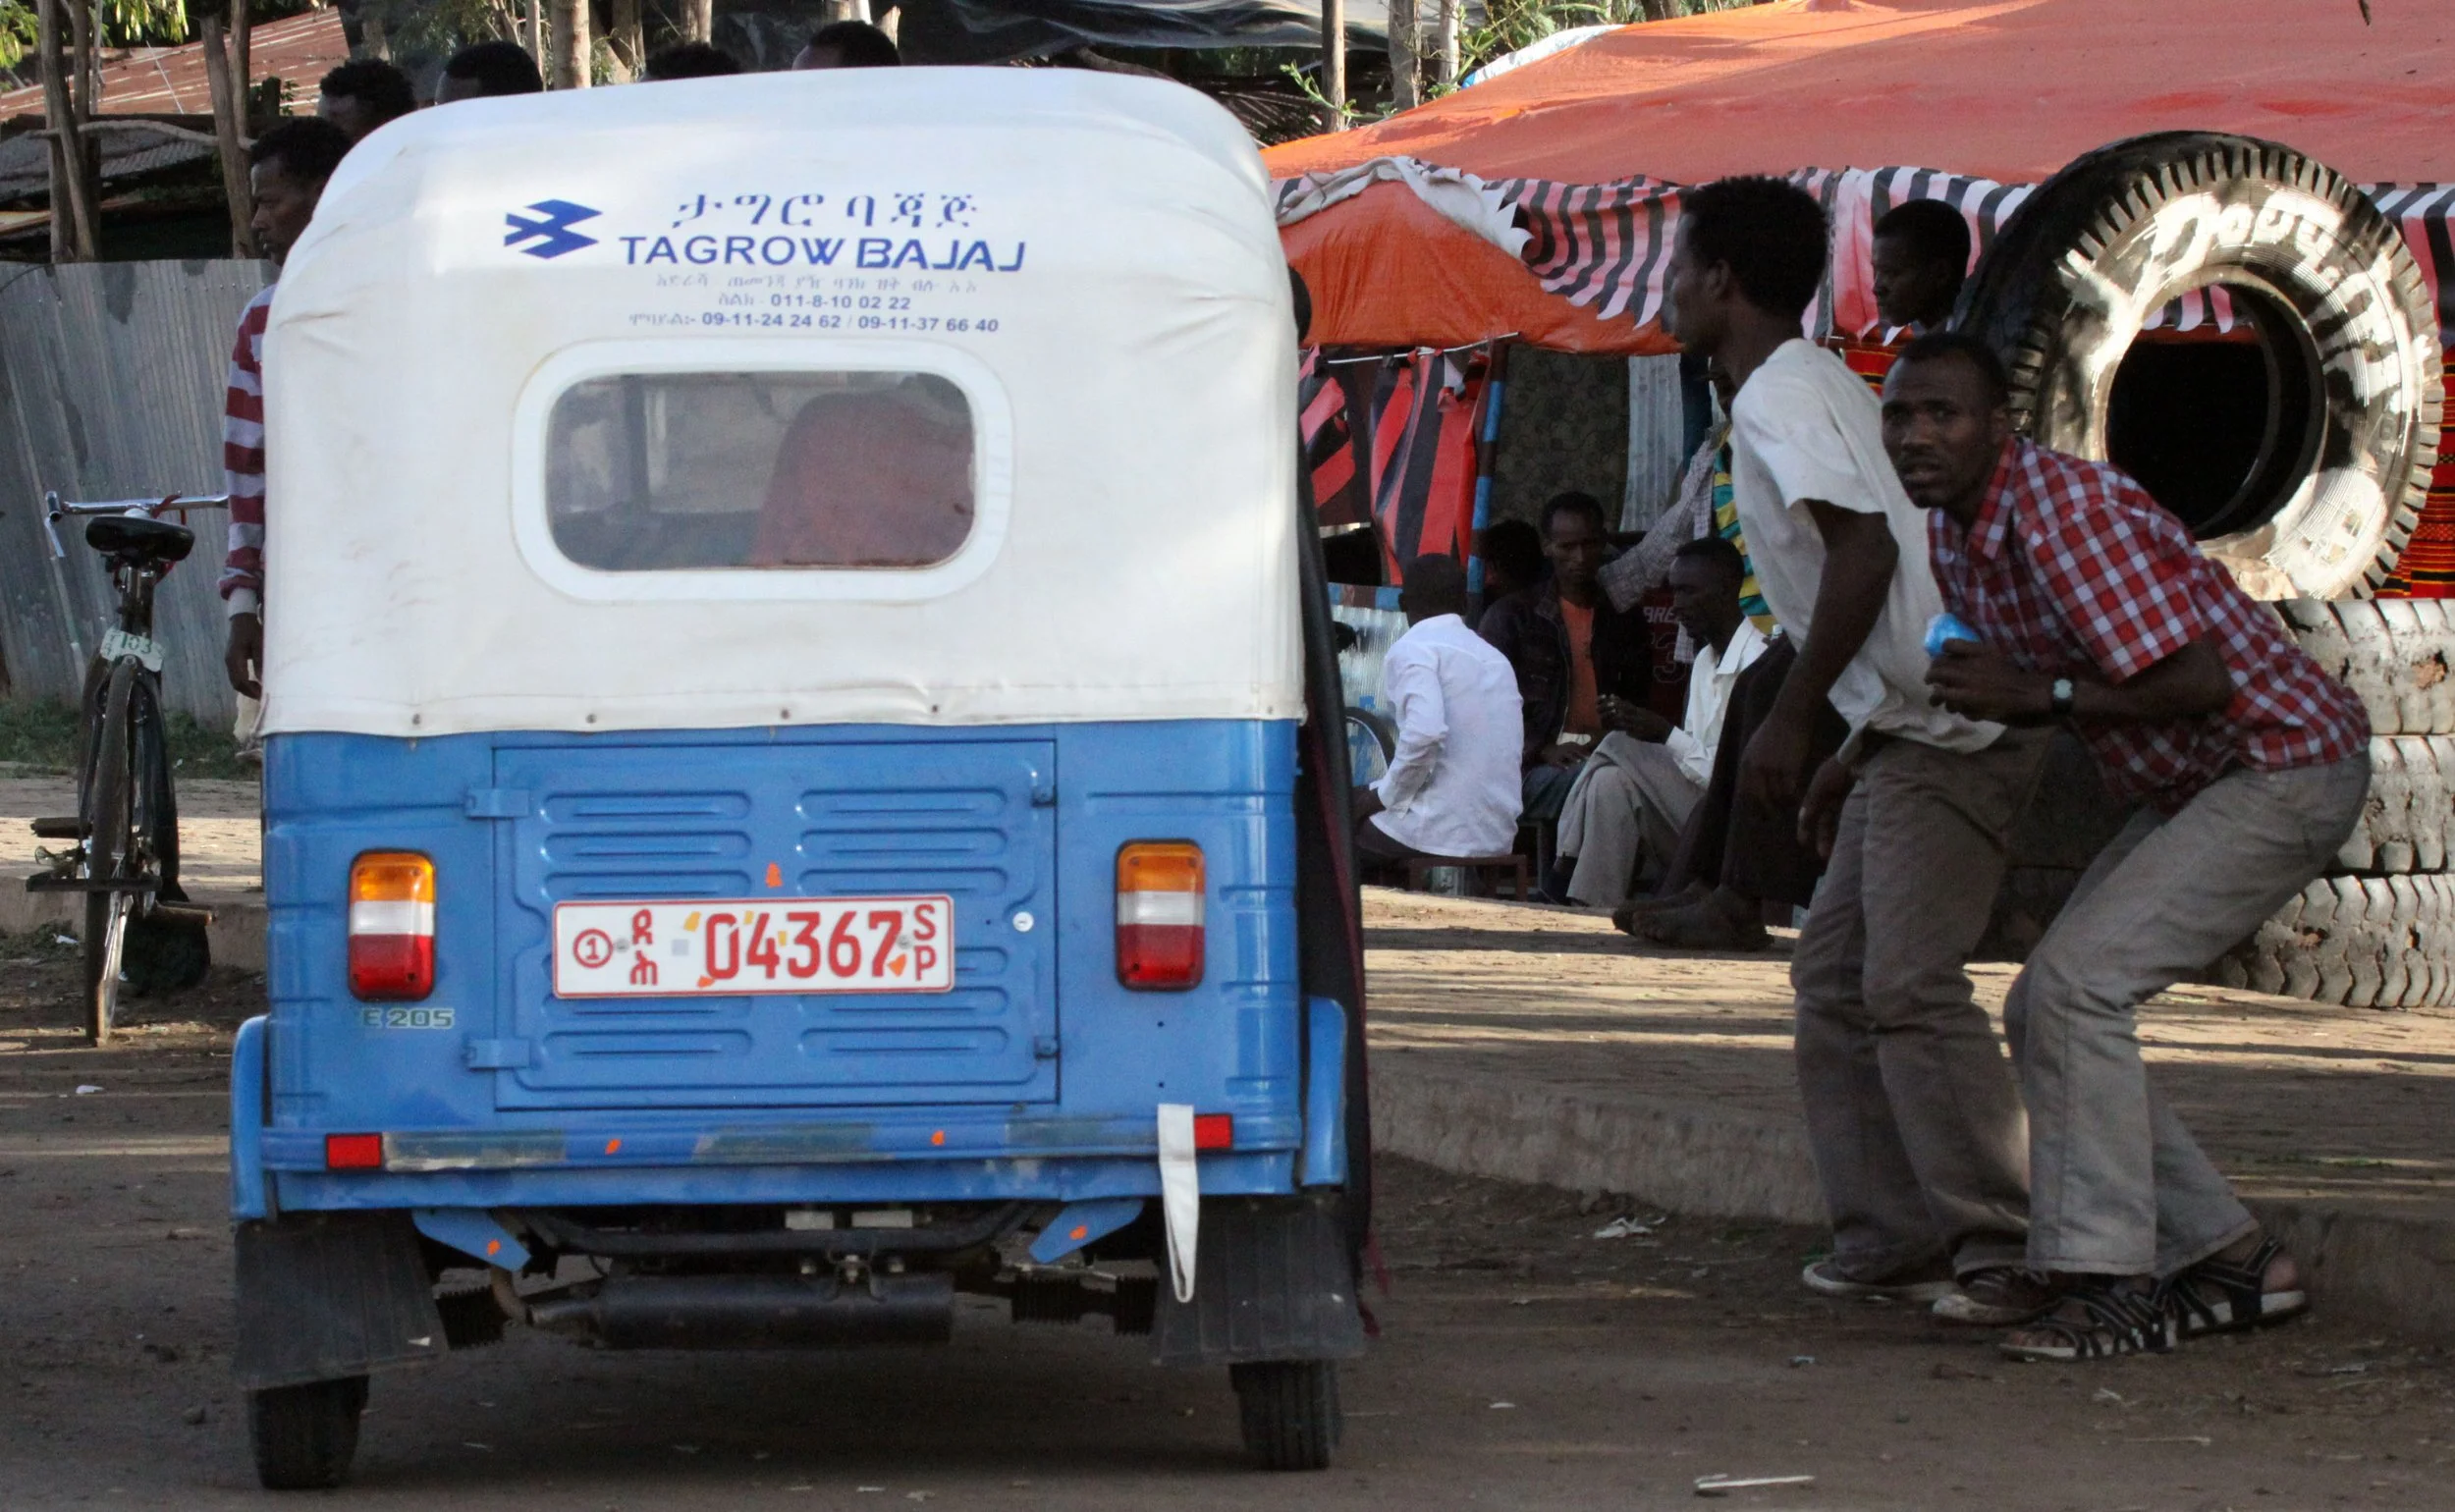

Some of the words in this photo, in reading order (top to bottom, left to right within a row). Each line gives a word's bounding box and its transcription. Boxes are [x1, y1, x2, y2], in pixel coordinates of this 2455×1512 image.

[619, 235, 845, 266] TAGROW
[856, 238, 1026, 272] BAJAJ
[770, 294, 852, 308] 011-8-10
[858, 296, 882, 309] 02
[888, 297, 911, 310] 22
[701, 311, 785, 326] 09-11-24
[790, 313, 813, 327] 24
[818, 314, 842, 329] 62
[857, 315, 940, 331] 09-11-37
[946, 318, 969, 332] 66
[974, 318, 1000, 333] 40
[705, 911, 902, 979] 04367
[387, 1008, 454, 1029] 205
